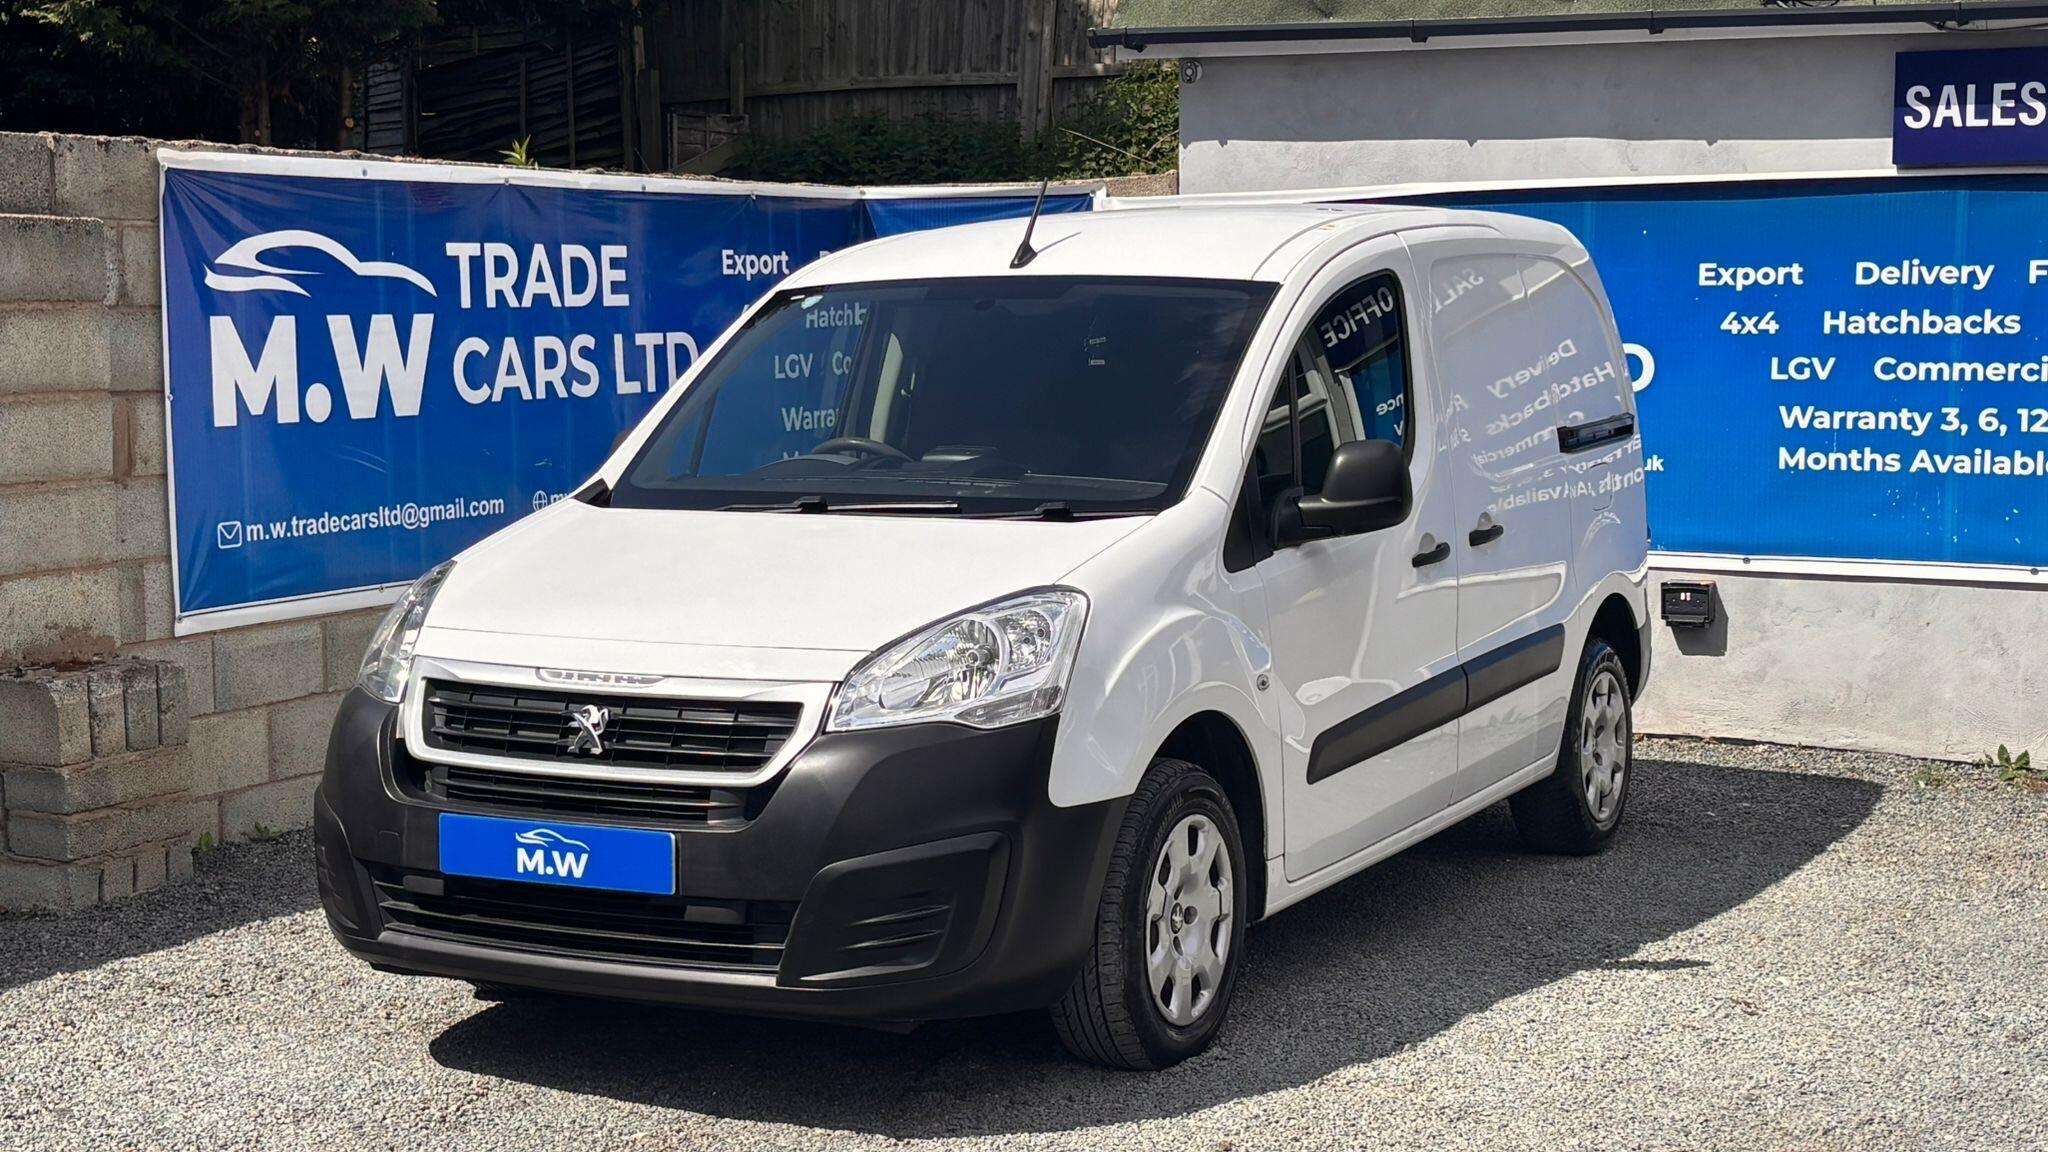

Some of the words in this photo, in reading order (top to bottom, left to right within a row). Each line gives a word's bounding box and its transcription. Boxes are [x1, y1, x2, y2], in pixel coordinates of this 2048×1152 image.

[1904, 82, 2046, 129] SALES
[446, 243, 630, 309] TRADE
[721, 250, 790, 281] Export
[1699, 263, 1804, 291] Export
[1855, 258, 1995, 291] Delivery
[1720, 311, 1780, 334] 4x4
[1823, 309, 2022, 335] Hatchbacks
[209, 313, 434, 427] M.W
[453, 333, 600, 404] CARS
[613, 331, 700, 395] LTD
[775, 353, 813, 379] LGV
[1771, 357, 1836, 381] LGV
[781, 406, 840, 432] Warra
[1778, 405, 1933, 436] Warranty
[1940, 407, 1969, 436] 3,
[1978, 407, 2008, 437] 6,
[2017, 408, 2048, 432] 12
[1778, 446, 1901, 471] Months
[1909, 448, 2048, 476] Availabl
[246, 497, 504, 542] m.w.tradecarsltd@gmail.com
[517, 847, 589, 879] M.W
